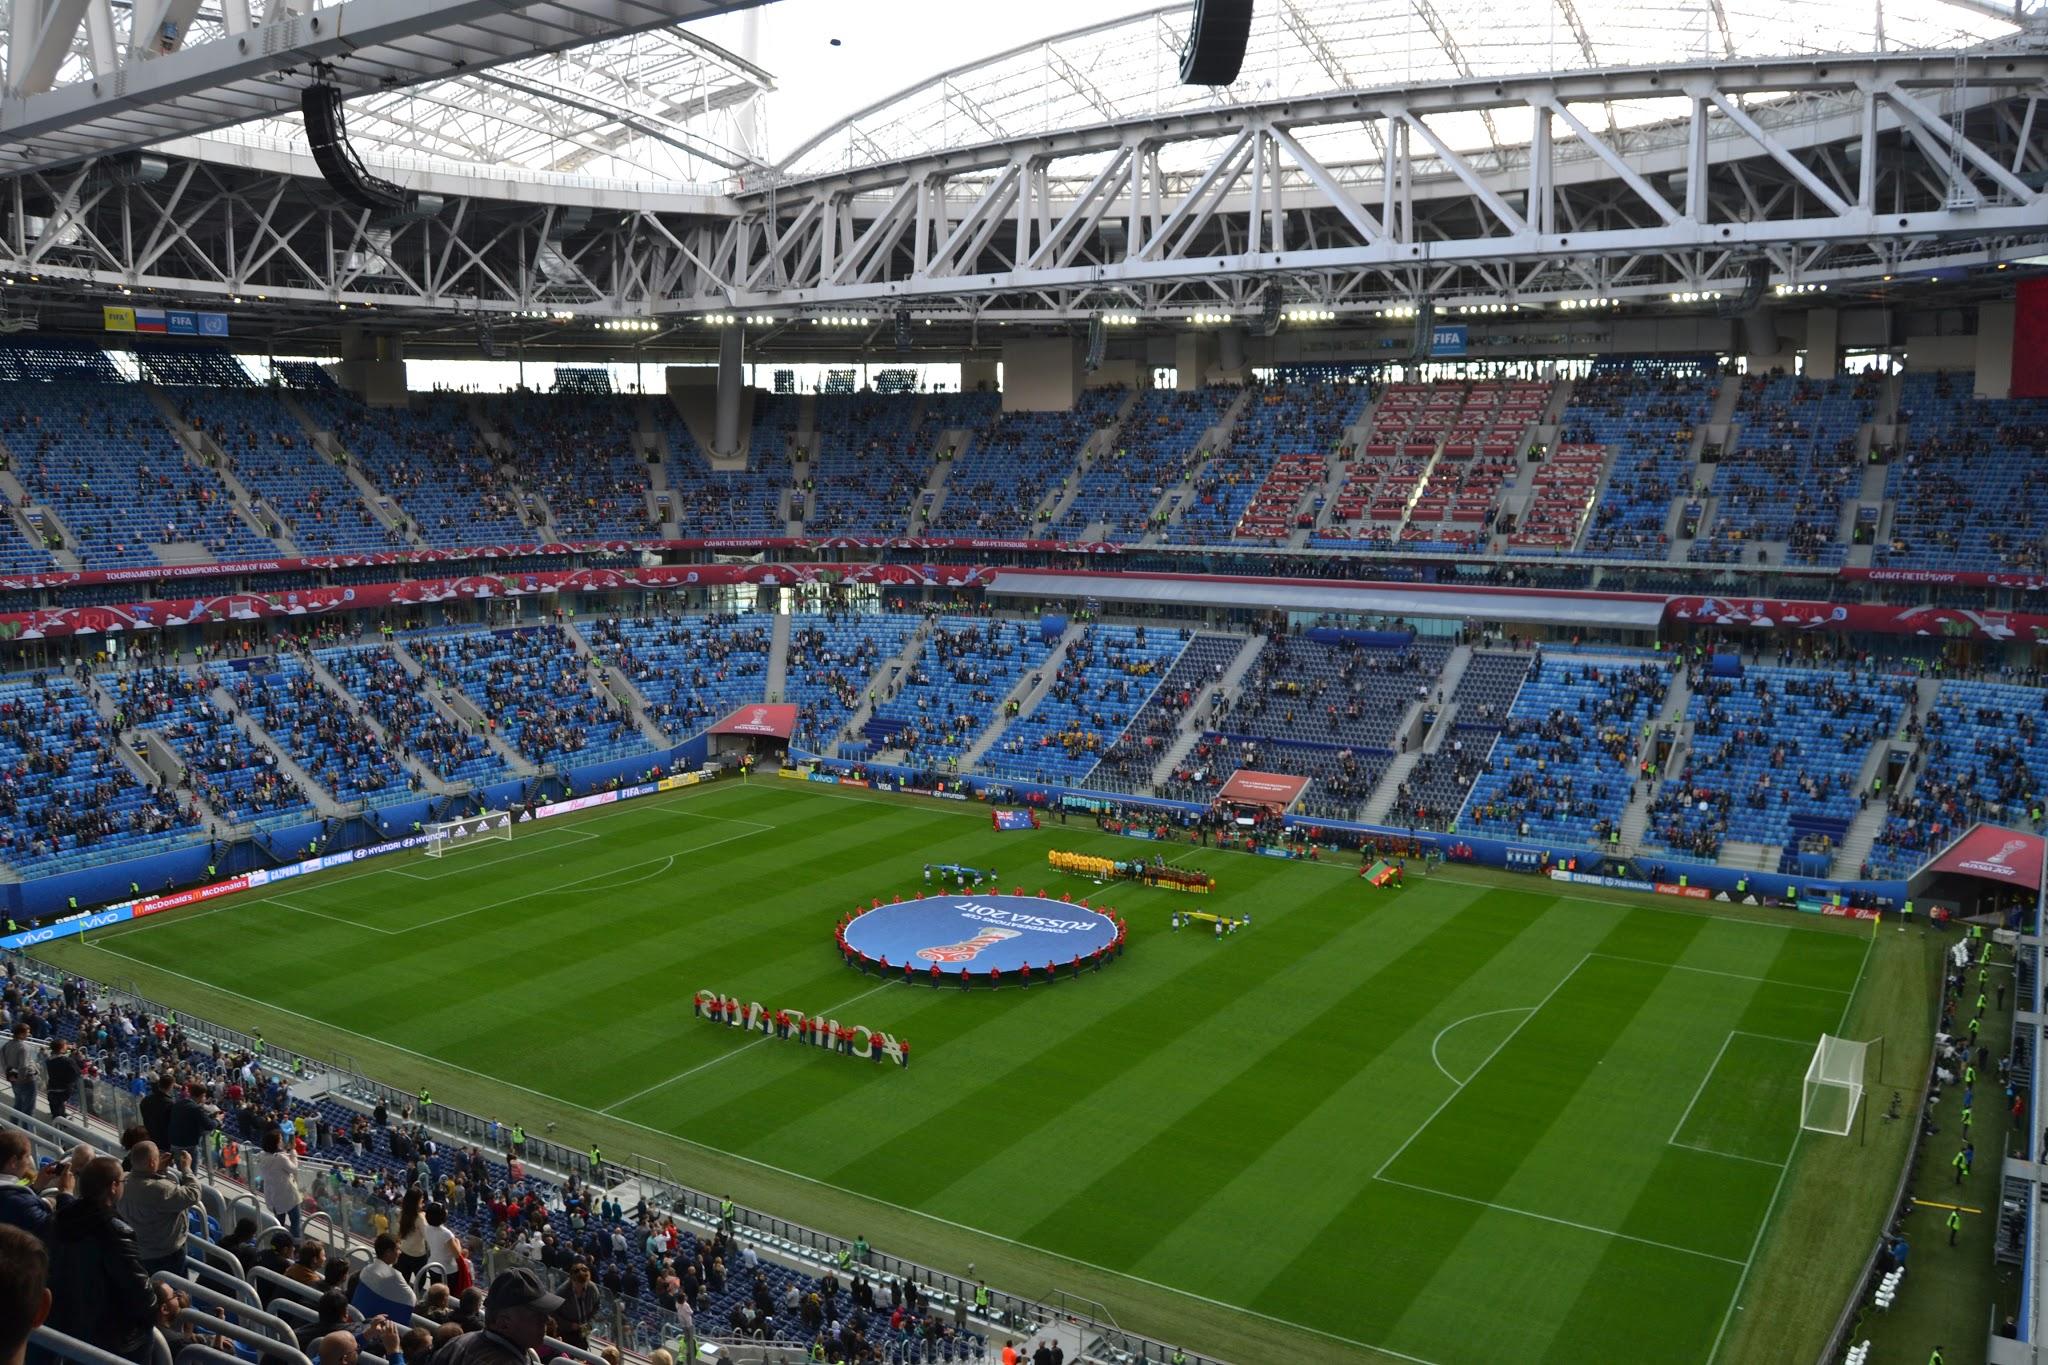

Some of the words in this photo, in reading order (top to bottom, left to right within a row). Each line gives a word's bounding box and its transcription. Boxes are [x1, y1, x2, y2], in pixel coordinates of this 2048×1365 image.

[171, 316, 192, 325] FIFA
[1433, 332, 1460, 344] FIFA
[106, 569, 161, 581] TOURNAMENT
[163, 568, 174, 577] OF
[221, 564, 248, 573] DREAM
[249, 563, 259, 571] OF
[813, 774, 833, 784] vivo
[877, 782, 892, 791] VISA
[415, 830, 448, 845] HYUNDAI
[368, 841, 401, 855] HYUNDAI
[201, 880, 247, 897] McDonald's
[144, 894, 193, 912] McDonald's
[954, 902, 1012, 919] 2017
[1823, 904, 1847, 916] Bud
[84, 913, 118, 928] vivo
[961, 912, 983, 921] CUP
[1011, 912, 1097, 931] RUSSIA
[981, 916, 1069, 935] CONFEDERATIONS
[16, 929, 54, 946] vivo
